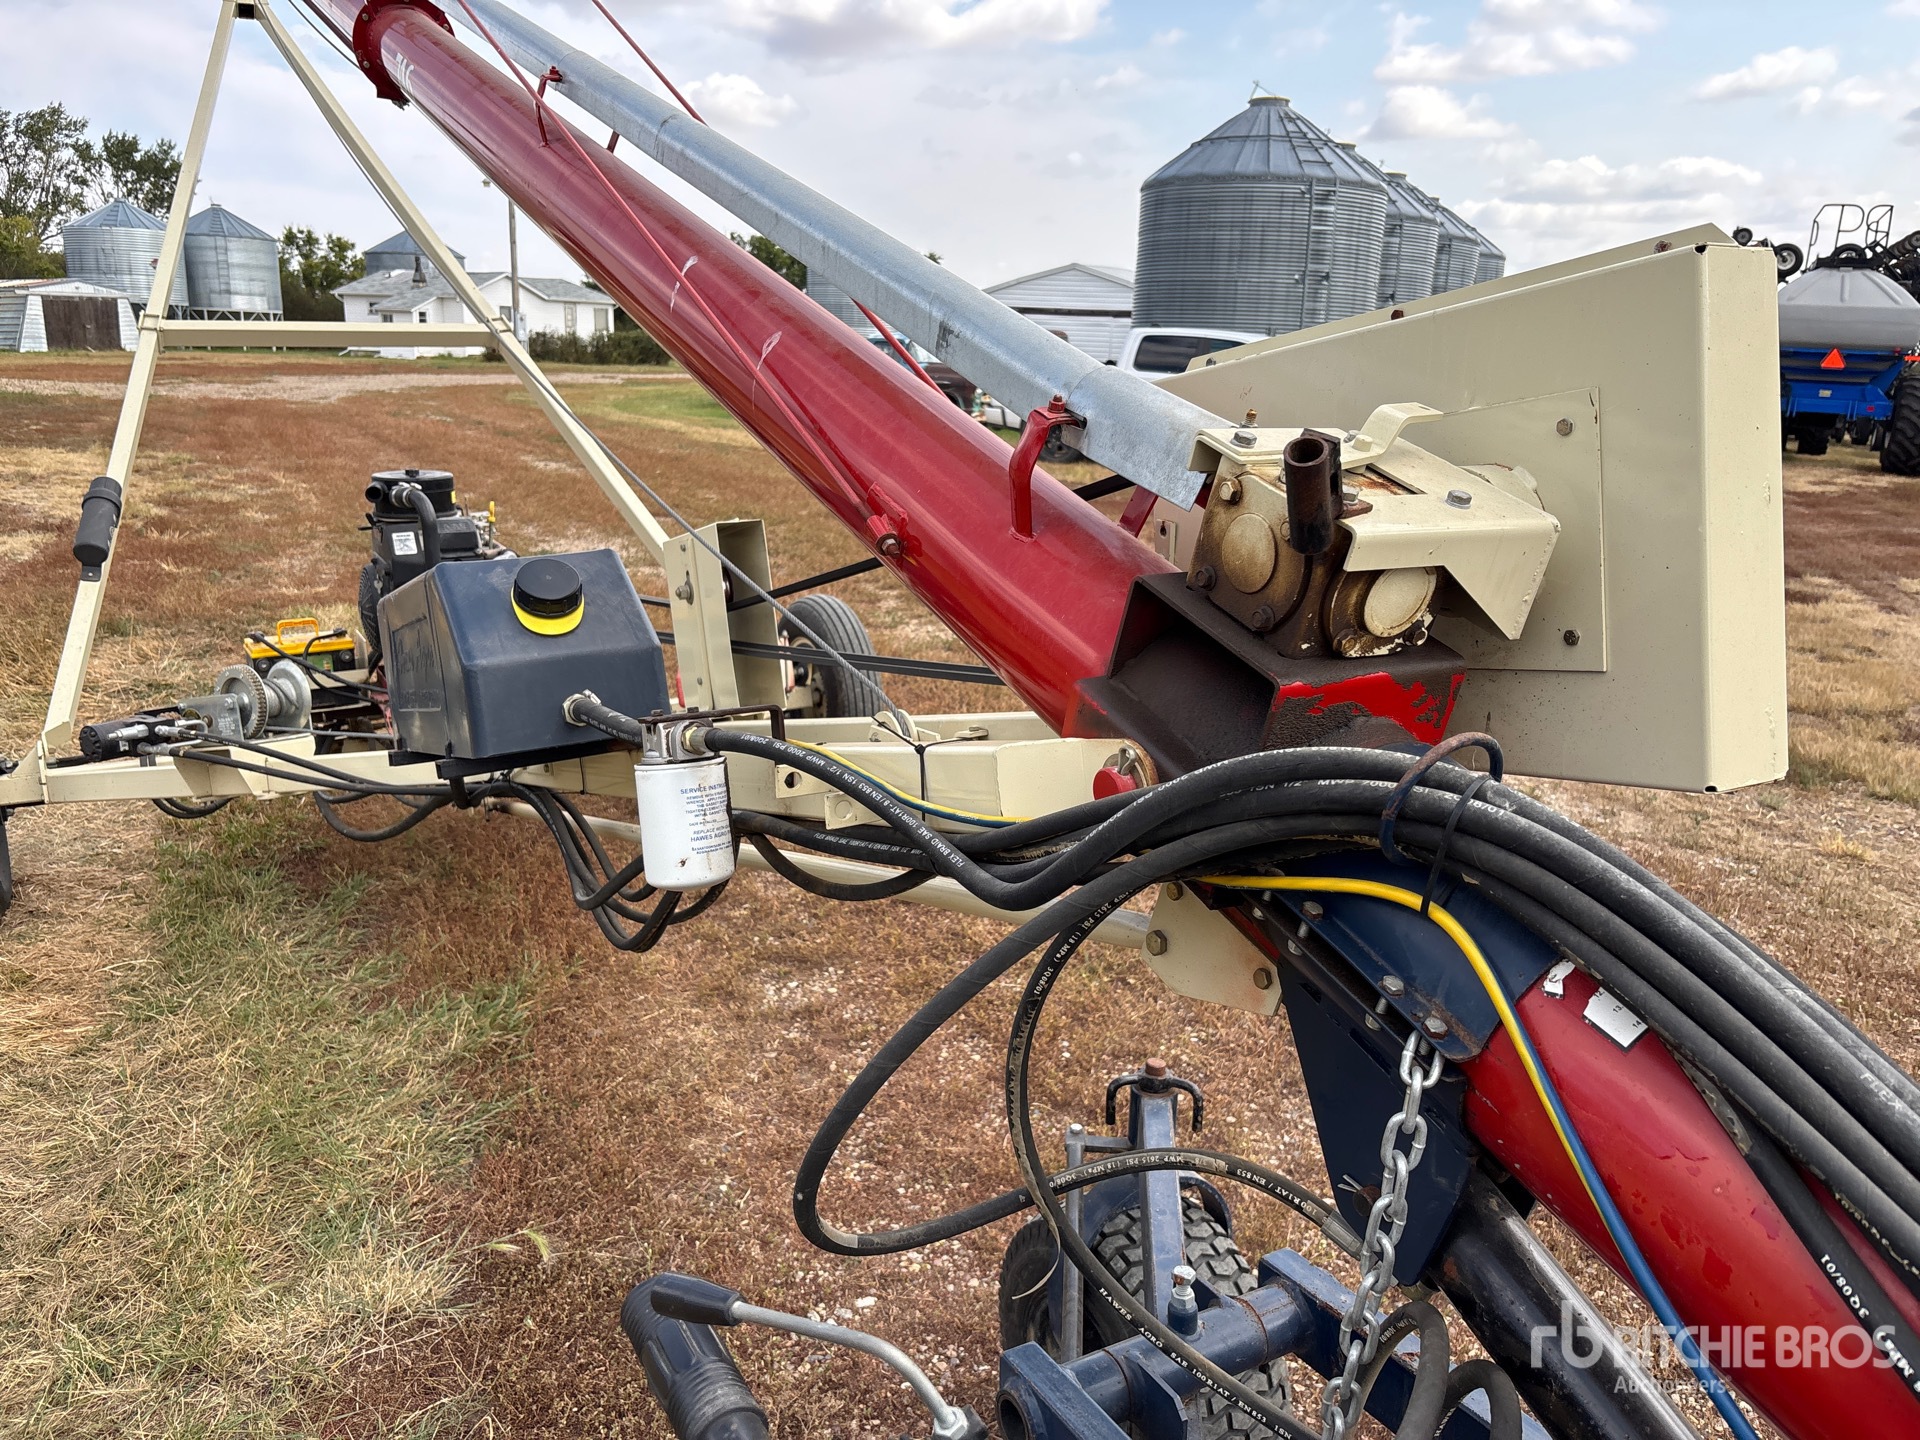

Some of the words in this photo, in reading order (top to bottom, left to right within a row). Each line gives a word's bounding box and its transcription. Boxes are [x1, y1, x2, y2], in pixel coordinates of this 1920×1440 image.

[773, 742, 787, 750] PSI
[787, 746, 806, 757] 2000
[806, 755, 826, 767] MWP
[842, 773, 857, 785] 1SN
[680, 785, 707, 795] SERVICE
[693, 827, 715, 835] REPLACE
[917, 827, 932, 840] SAE
[690, 834, 713, 842] HAWES
[931, 839, 950, 855] BRAID
[948, 855, 965, 868] FLEX
[1094, 902, 1112, 918] 2615
[1081, 917, 1095, 930] PSI
[1033, 966, 1054, 995] 3Q08/01
[1126, 1158, 1139, 1166] PSI
[1142, 1155, 1160, 1164] 2615
[1163, 1154, 1185, 1164] MWP
[1821, 1254, 1870, 1318] 3Q08/01
[1099, 1287, 1132, 1321] HAWES
[1139, 1327, 1163, 1348] AGRO
[1273, 1425, 1292, 1440] 1SN
